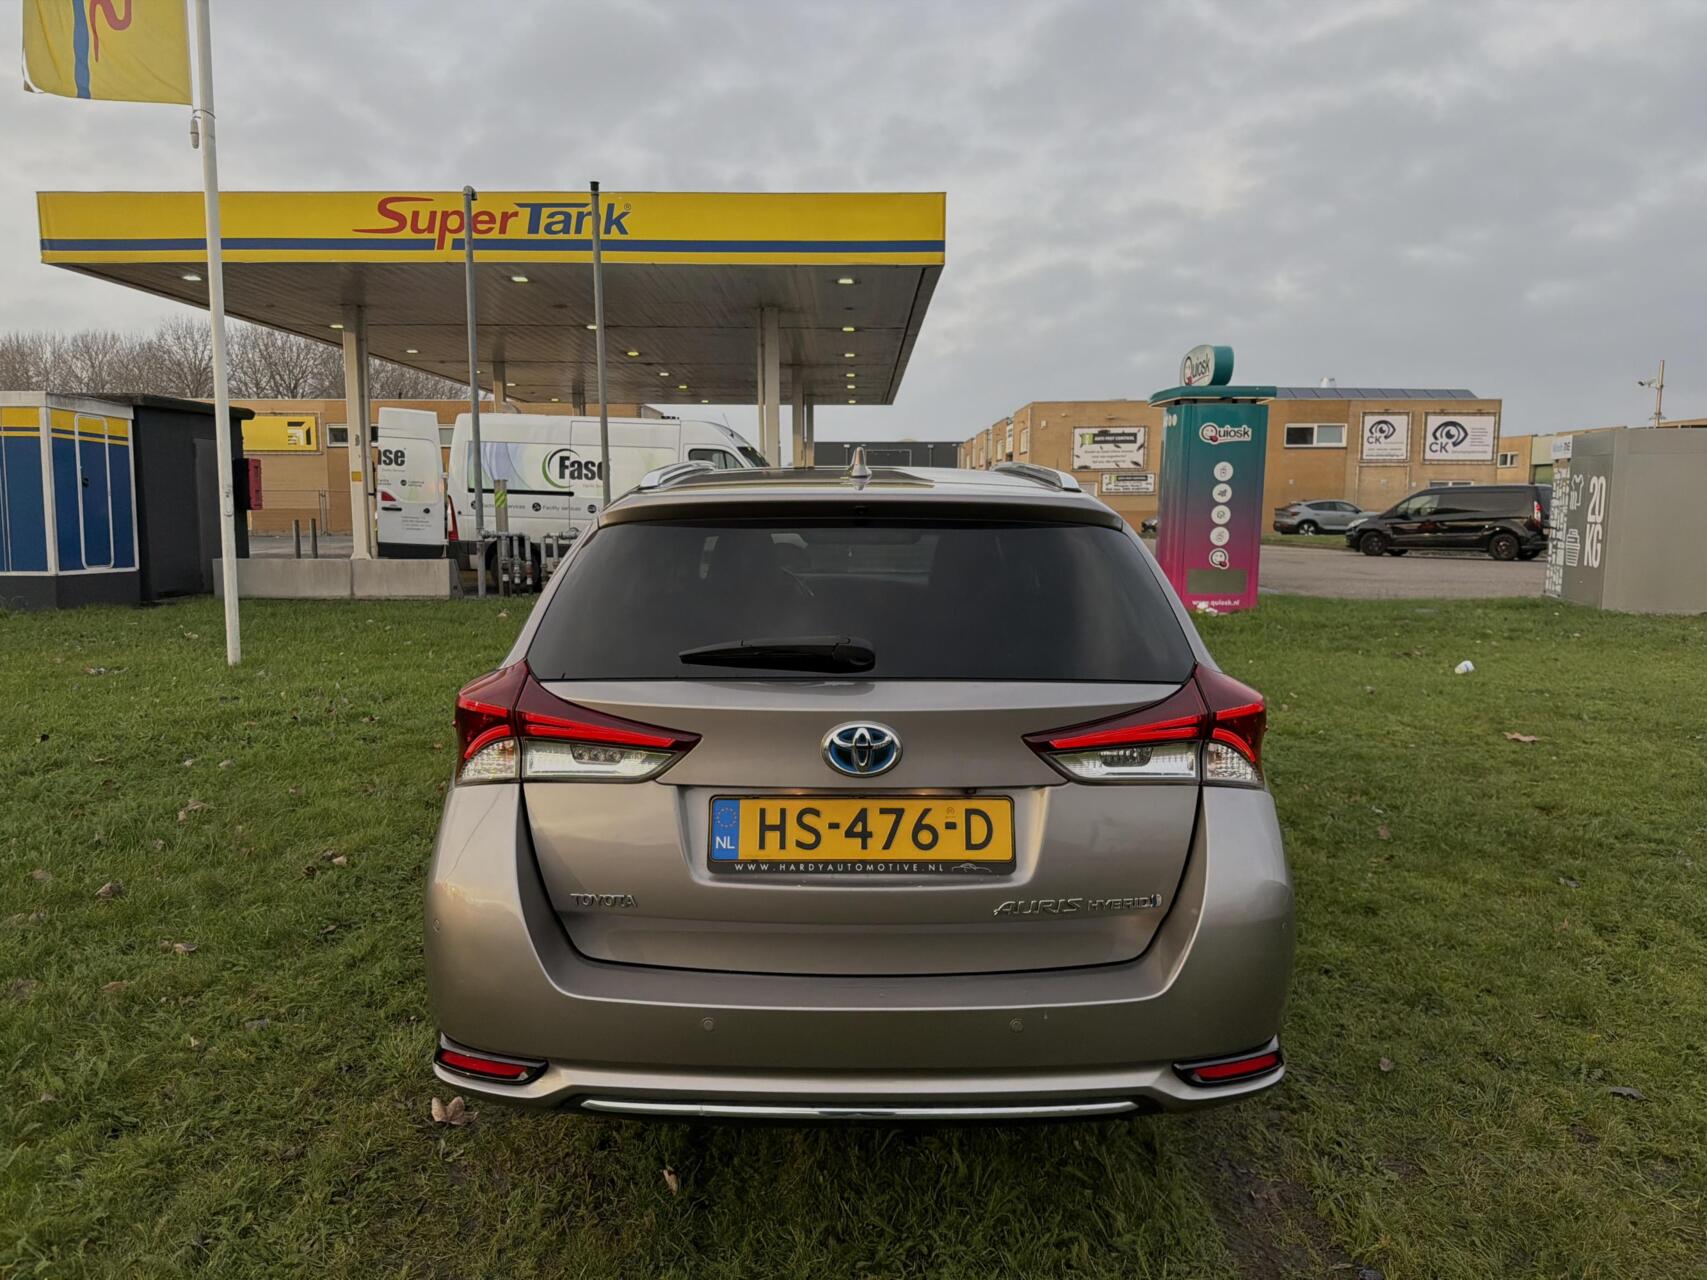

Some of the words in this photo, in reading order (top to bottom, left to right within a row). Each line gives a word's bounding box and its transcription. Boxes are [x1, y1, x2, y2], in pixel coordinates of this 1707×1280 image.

[1201, 423, 1251, 443] Quiosk
[1366, 435, 1382, 445] CK
[1429, 441, 1450, 454] CK
[378, 448, 406, 467] se
[1588, 475, 1606, 523] 20
[1583, 523, 1603, 568] KG
[758, 807, 994, 851] HS-476-D
[715, 836, 735, 849] NL
[734, 863, 944, 873] WWW.HARDYAUTOMOTIVE.NL
[569, 893, 639, 908] TOYOTA
[992, 897, 1084, 917] AURIS
[1087, 896, 1154, 912] HYBRID
